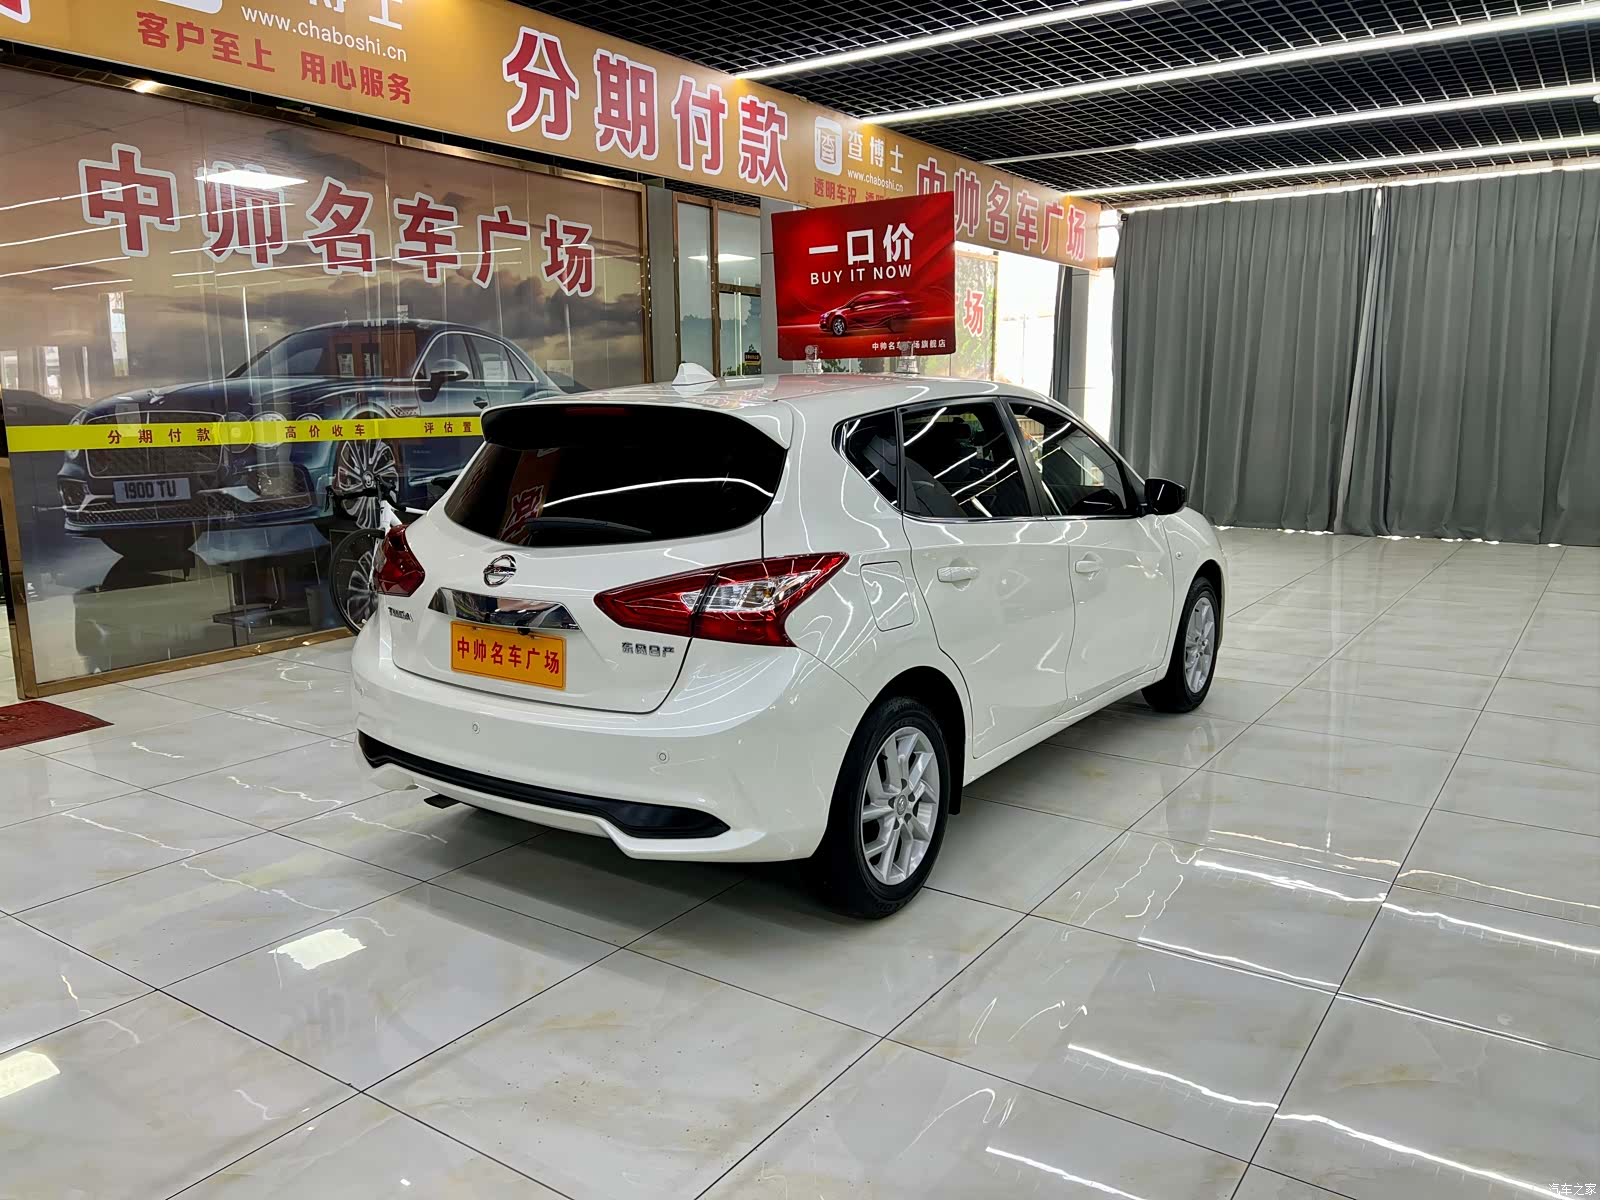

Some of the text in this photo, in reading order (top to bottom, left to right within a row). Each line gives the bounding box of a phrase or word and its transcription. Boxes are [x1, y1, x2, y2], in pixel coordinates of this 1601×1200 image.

[241, 6, 407, 62] www.chaboshi.cn
[136, 11, 275, 72] 客户至上
[300, 51, 411, 105] 用心服务
[503, 26, 788, 191] 分期付款
[847, 130, 904, 174] 查博士
[814, 177, 857, 204] 透明车况
[847, 169, 904, 192] www.chaboshi.cn
[79, 143, 595, 297] 中帅名车广场
[808, 223, 914, 265] 一口价
[810, 264, 912, 285] BUY IT NOW
[955, 287, 984, 338] 场
[872, 339, 946, 351] 中帅名场旗舰店
[107, 421, 472, 445] 分期付款 高价收车 评估置
[123, 480, 177, 499] 1900 TU
[457, 636, 560, 674] 中帅名车广场
[621, 642, 675, 657] 东风日产
